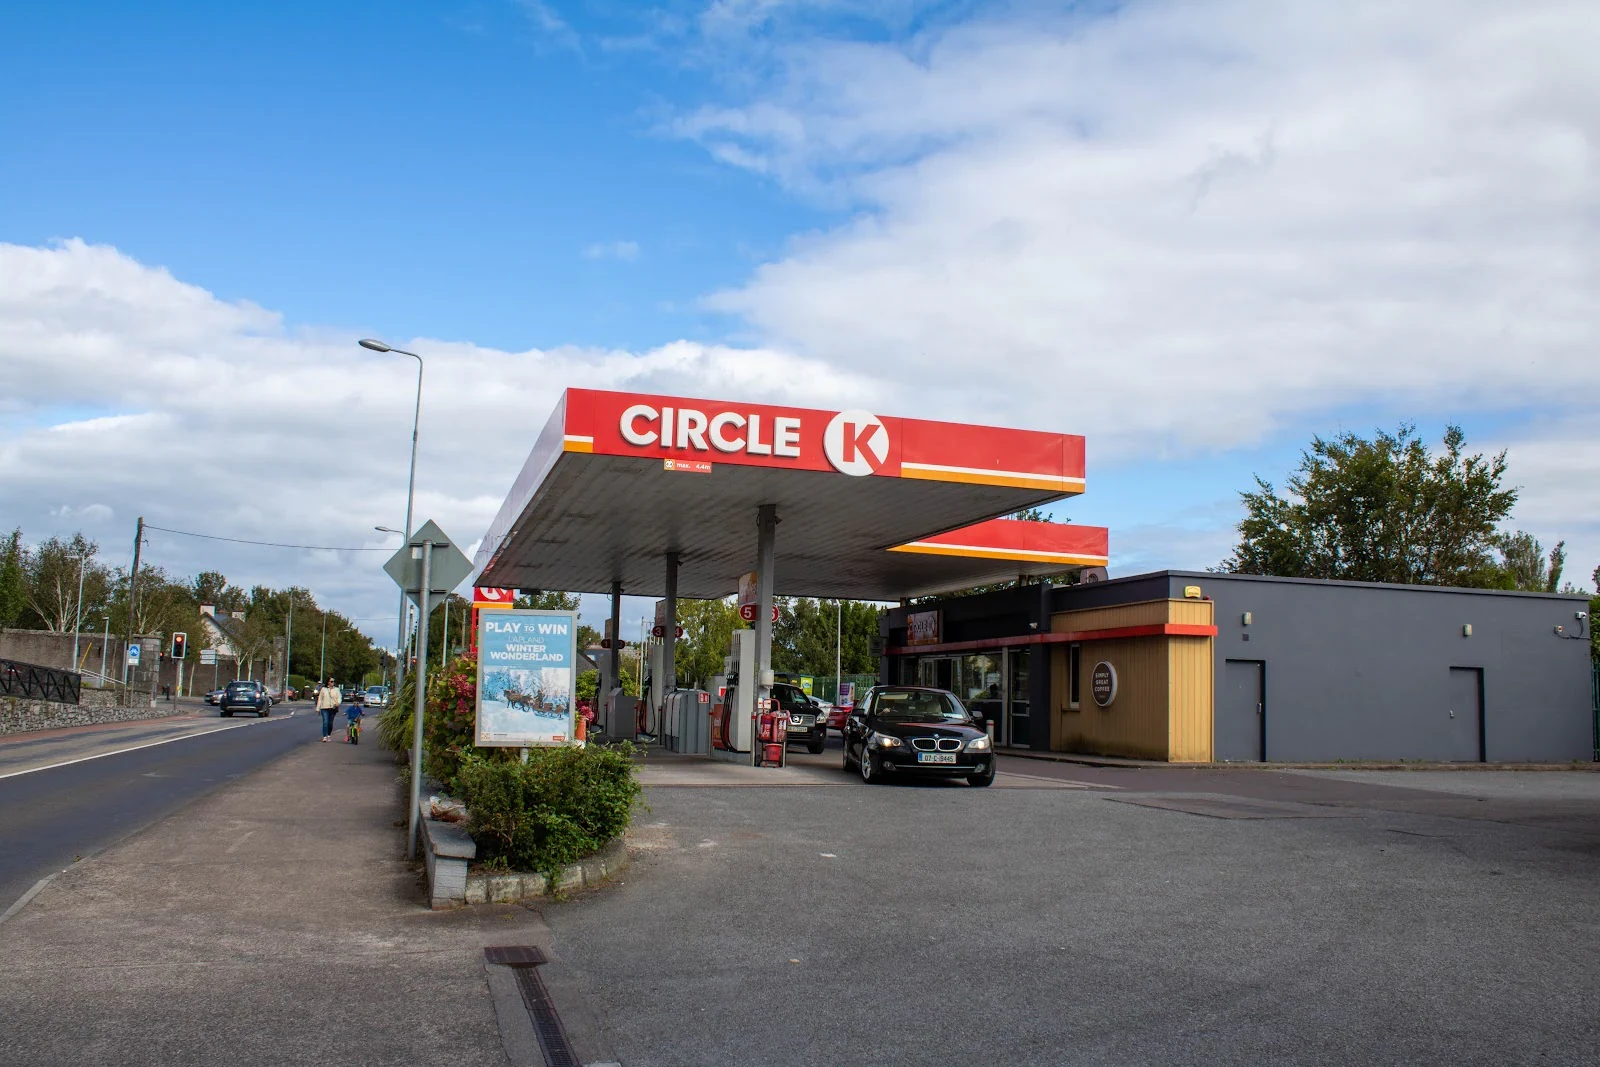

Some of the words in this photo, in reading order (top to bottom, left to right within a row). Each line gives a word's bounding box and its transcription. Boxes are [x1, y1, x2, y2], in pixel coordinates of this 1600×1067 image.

[619, 404, 801, 457] CIRCLE
[841, 419, 885, 473] K
[743, 607, 752, 619] 5
[485, 622, 522, 633] PLAY
[537, 623, 568, 635] WIN
[655, 627, 662, 636] 3
[675, 627, 681, 637] 4
[508, 635, 545, 644] LAPLAND
[505, 643, 547, 653] WINTER
[490, 651, 564, 662] WONDERLAND
